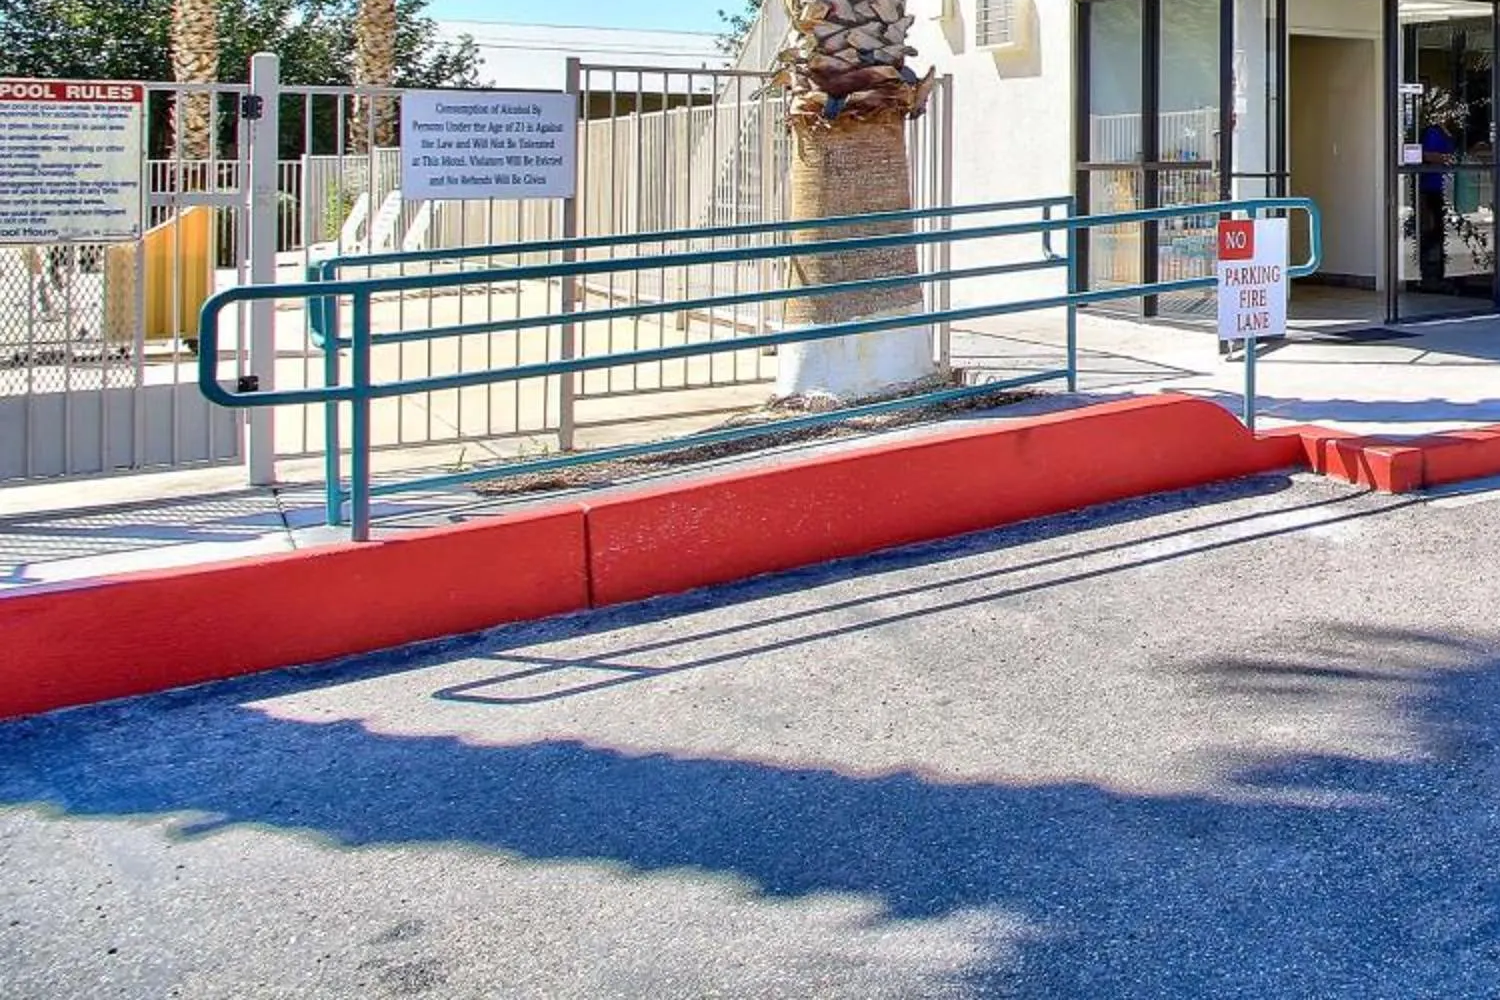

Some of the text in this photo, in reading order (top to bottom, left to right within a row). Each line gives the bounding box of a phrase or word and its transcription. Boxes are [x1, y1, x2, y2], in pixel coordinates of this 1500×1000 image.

[0, 84, 134, 99] POOL RULES
[532, 103, 542, 115] By
[446, 121, 471, 133] Under
[473, 121, 487, 133] the
[488, 121, 503, 133] Age
[514, 121, 525, 133] 21
[436, 138, 453, 149] Law
[456, 138, 470, 149] and
[422, 155, 439, 167] This
[524, 155, 534, 167] Be
[511, 174, 522, 185] Be
[0, 227, 20, 236] ool
[1225, 231, 1247, 249] NO
[1225, 265, 1281, 287] PARKING
[1239, 289, 1267, 309] FIRE
[1236, 311, 1270, 332] LANE
